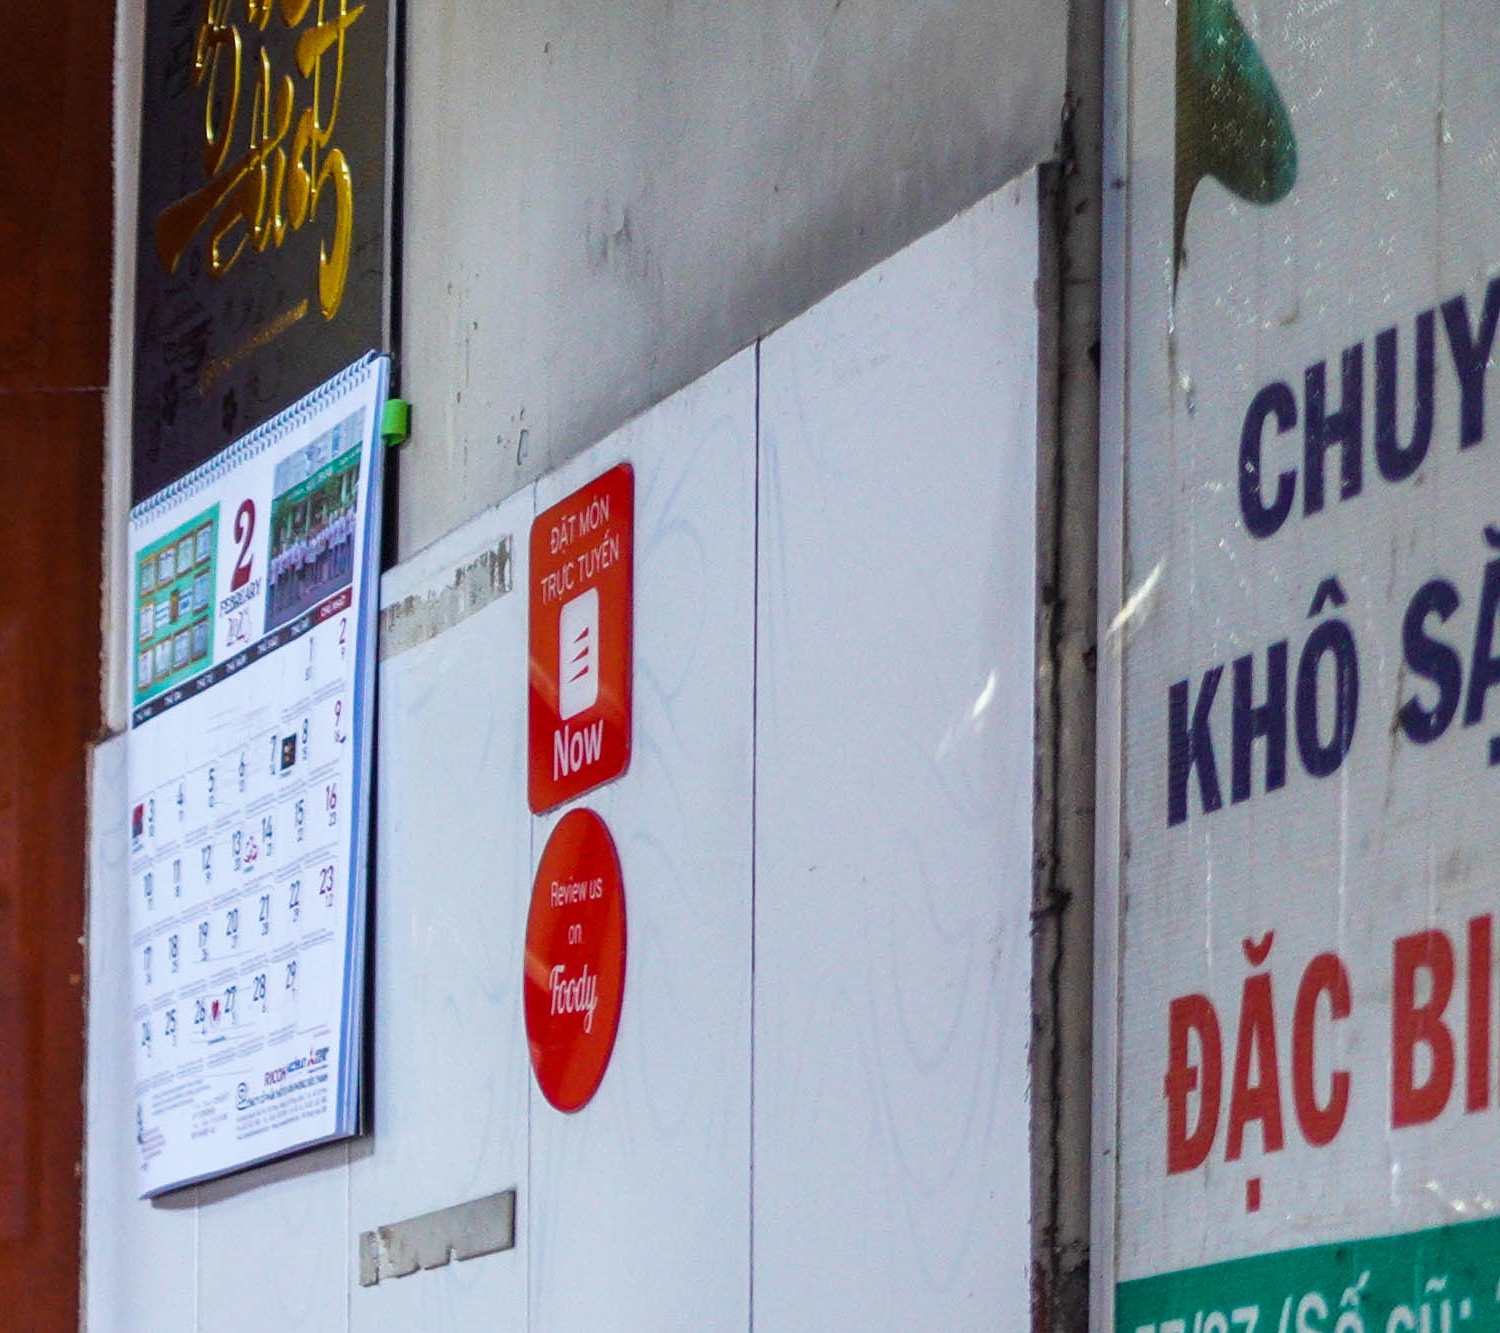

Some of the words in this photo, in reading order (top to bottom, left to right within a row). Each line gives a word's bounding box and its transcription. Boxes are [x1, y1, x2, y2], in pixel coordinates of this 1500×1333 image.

[1238, 277, 1500, 539] CHUY
[230, 498, 257, 592] 2
[550, 514, 576, 556] ĐẶT
[577, 529, 620, 583] TUYẾN
[338, 617, 347, 645] 2
[1167, 575, 1360, 831] KHÔ
[553, 720, 604, 781] Now
[326, 782, 338, 812] 16
[318, 865, 334, 895] 23
[551, 876, 588, 908] Review
[589, 877, 603, 899] us
[568, 923, 582, 945] on
[253, 973, 266, 1002] 28
[550, 964, 598, 1033] Foody
[1164, 929, 1353, 1214] ĐẶC
